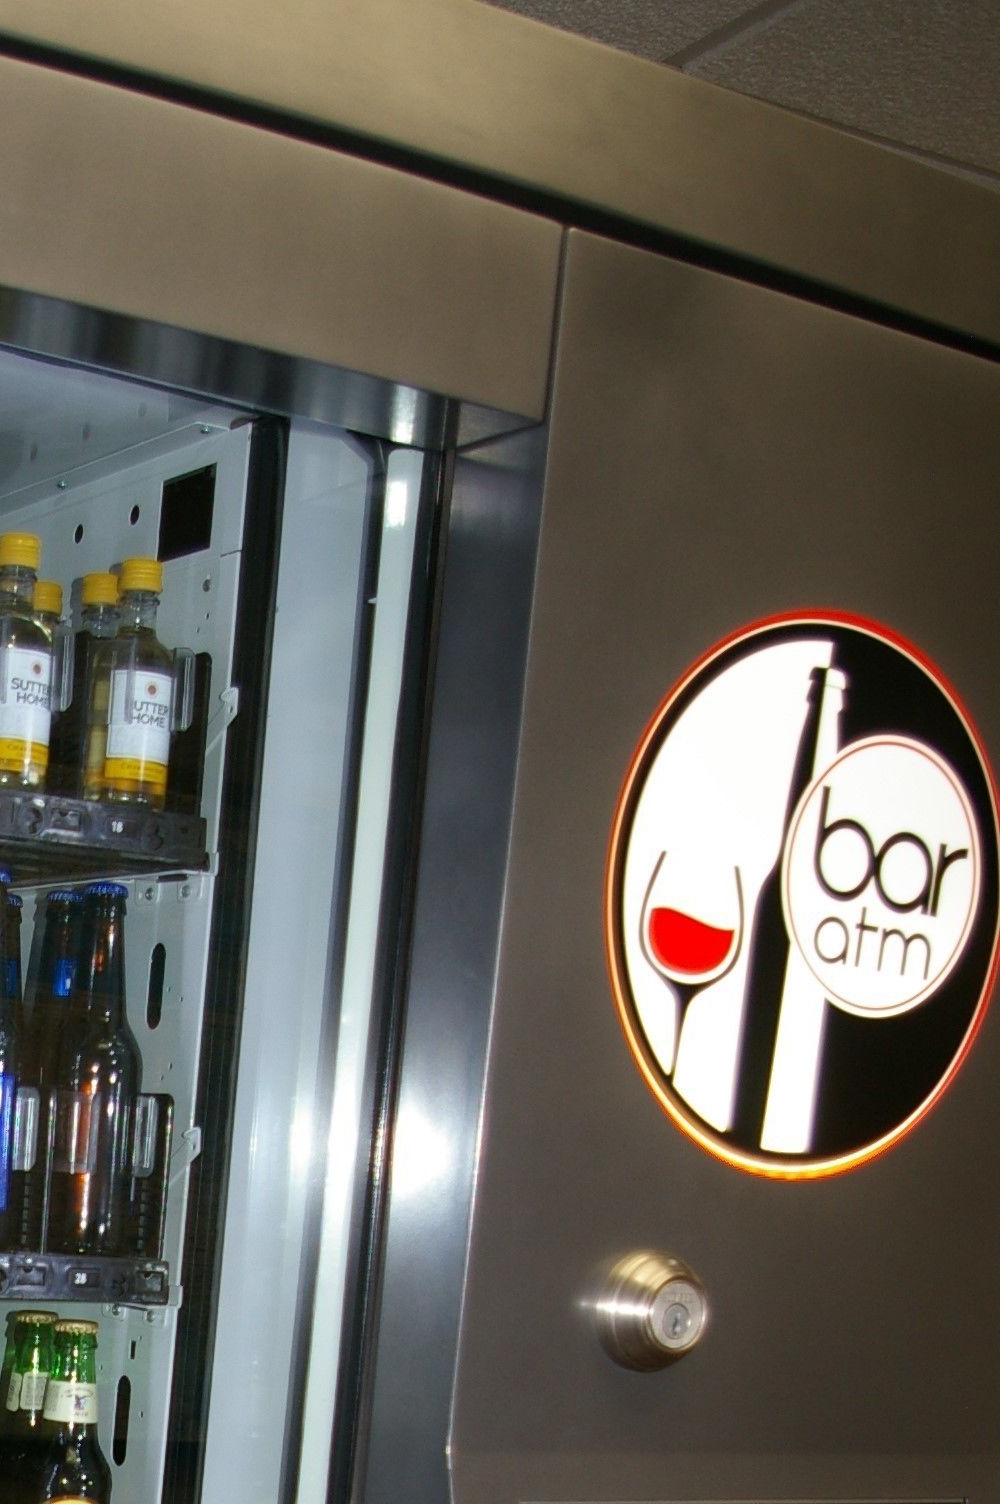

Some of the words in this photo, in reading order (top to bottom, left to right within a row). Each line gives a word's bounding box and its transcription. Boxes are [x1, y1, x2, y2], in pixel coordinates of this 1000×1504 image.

[111, 820, 124, 833] 18
[813, 785, 969, 917] bar
[813, 906, 932, 981] atm
[74, 1272, 87, 1285] 28
